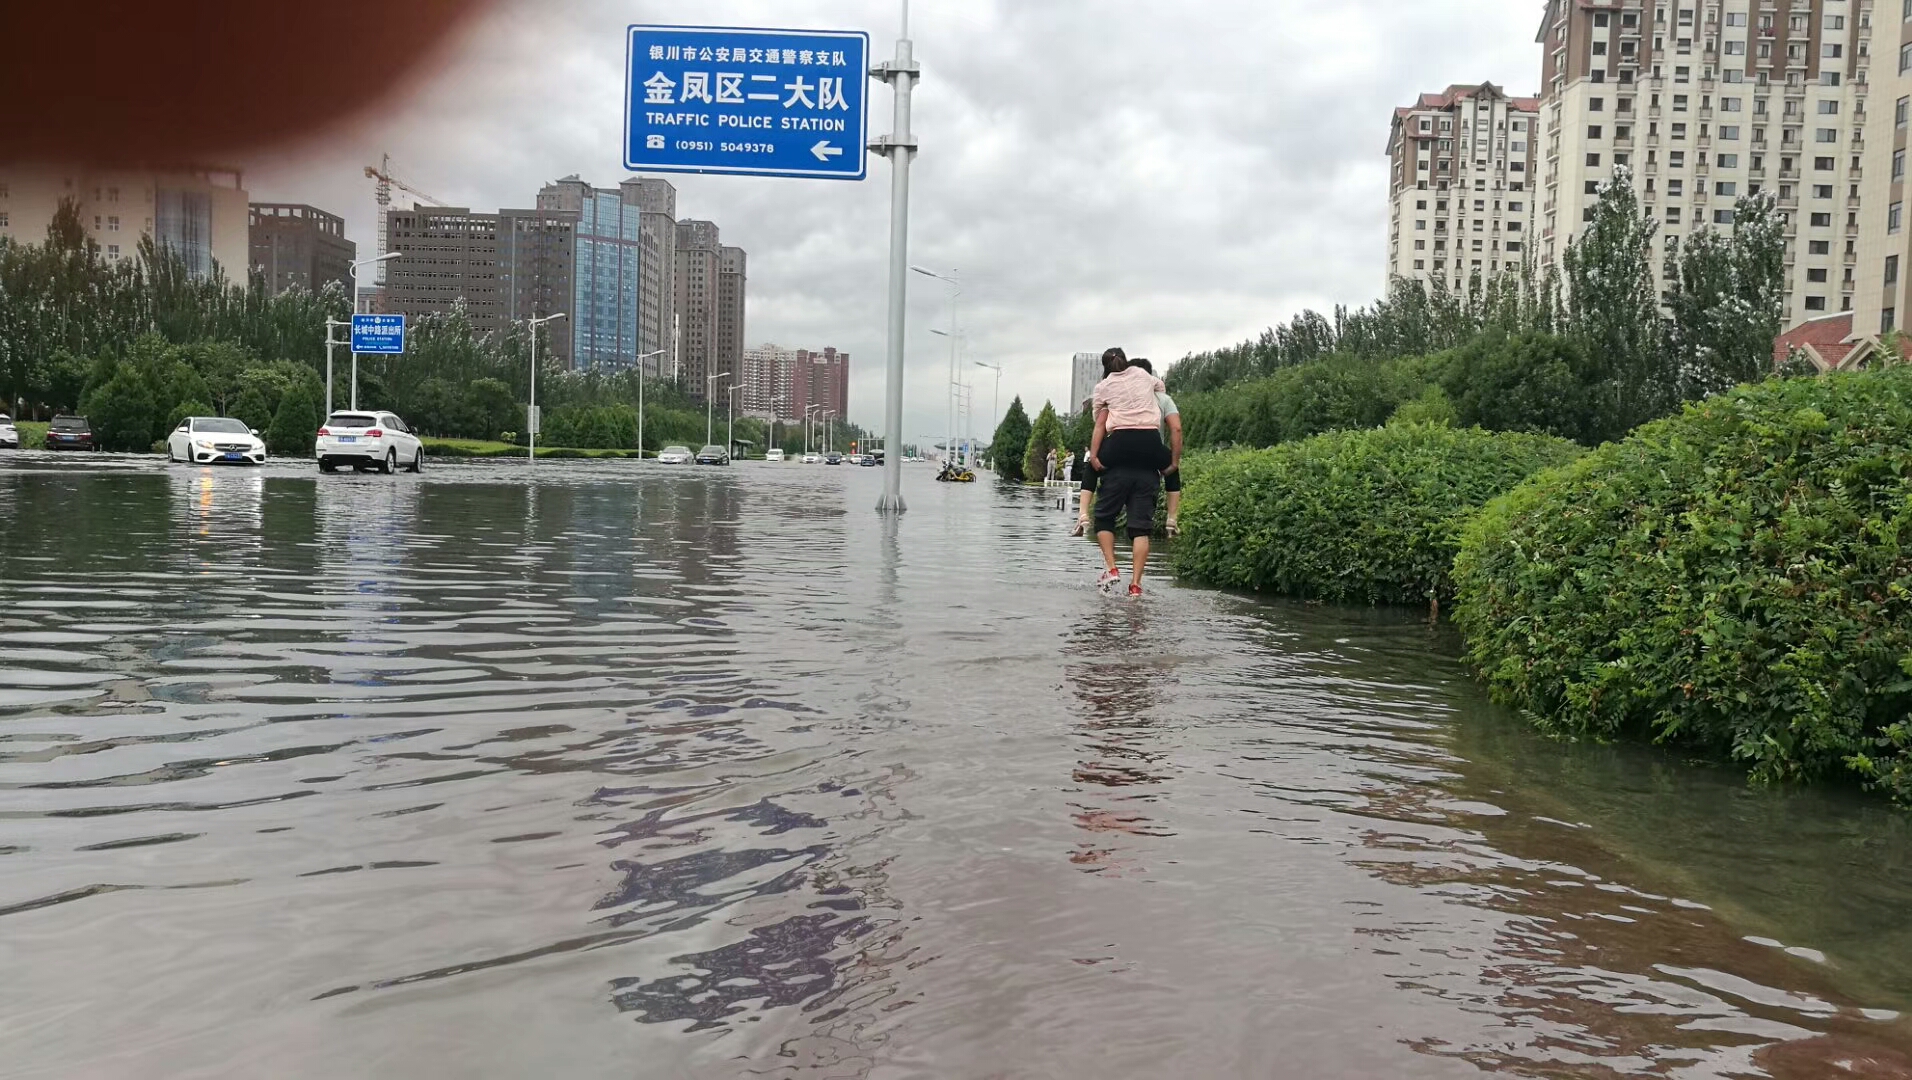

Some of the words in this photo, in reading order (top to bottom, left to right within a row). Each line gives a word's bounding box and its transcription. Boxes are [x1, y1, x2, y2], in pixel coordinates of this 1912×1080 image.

[649, 44, 847, 66] 银川市公安局交通警察支队
[643, 70, 849, 111] 金凤区二大队
[646, 112, 710, 126] TRAFFIC
[718, 114, 772, 129] POLICE
[781, 117, 845, 131] STATION
[675, 139, 713, 151] (0951)
[720, 142, 774, 153] 5049378
[354, 324, 401, 336] 长城中路派出所
